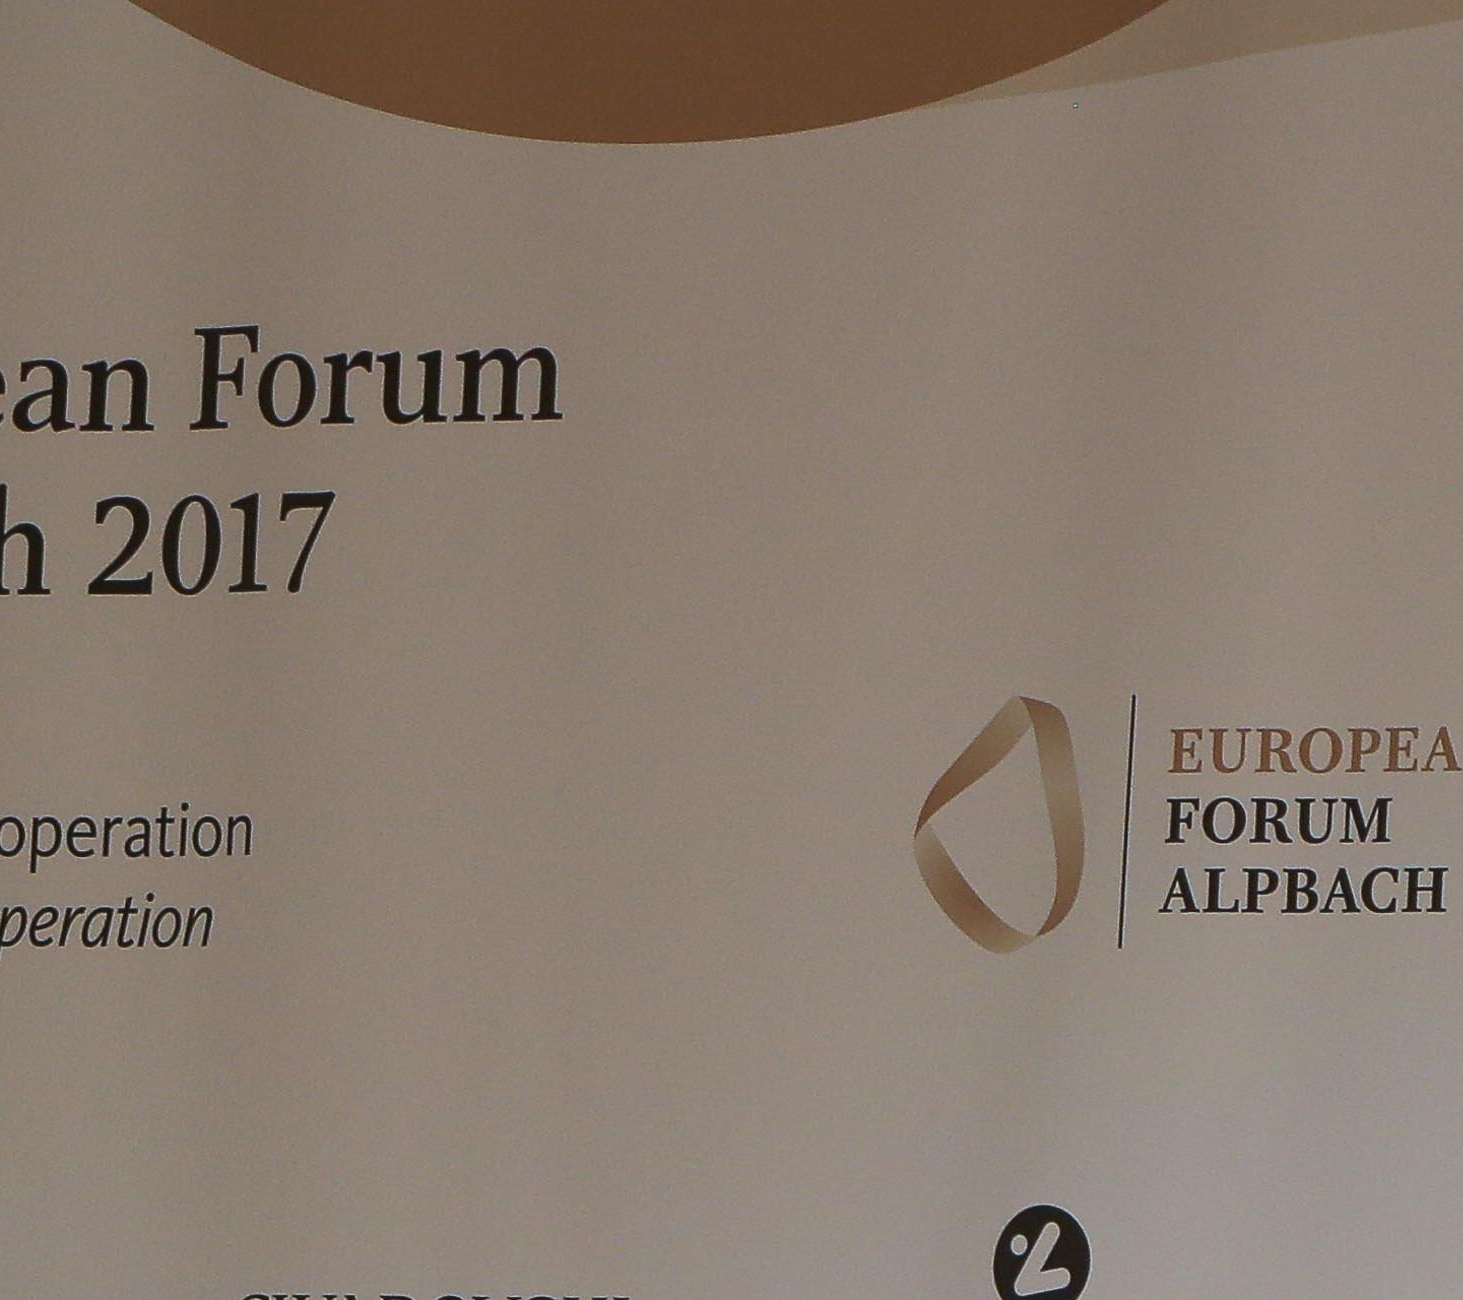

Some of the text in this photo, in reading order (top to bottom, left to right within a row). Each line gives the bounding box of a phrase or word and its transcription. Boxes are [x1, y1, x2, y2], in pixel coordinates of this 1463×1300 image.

[188, 324, 564, 431] Forum
[87, 490, 337, 596] 2017
[1163, 797, 1394, 845] FORUM
[1157, 866, 1450, 914] ALPBACH
